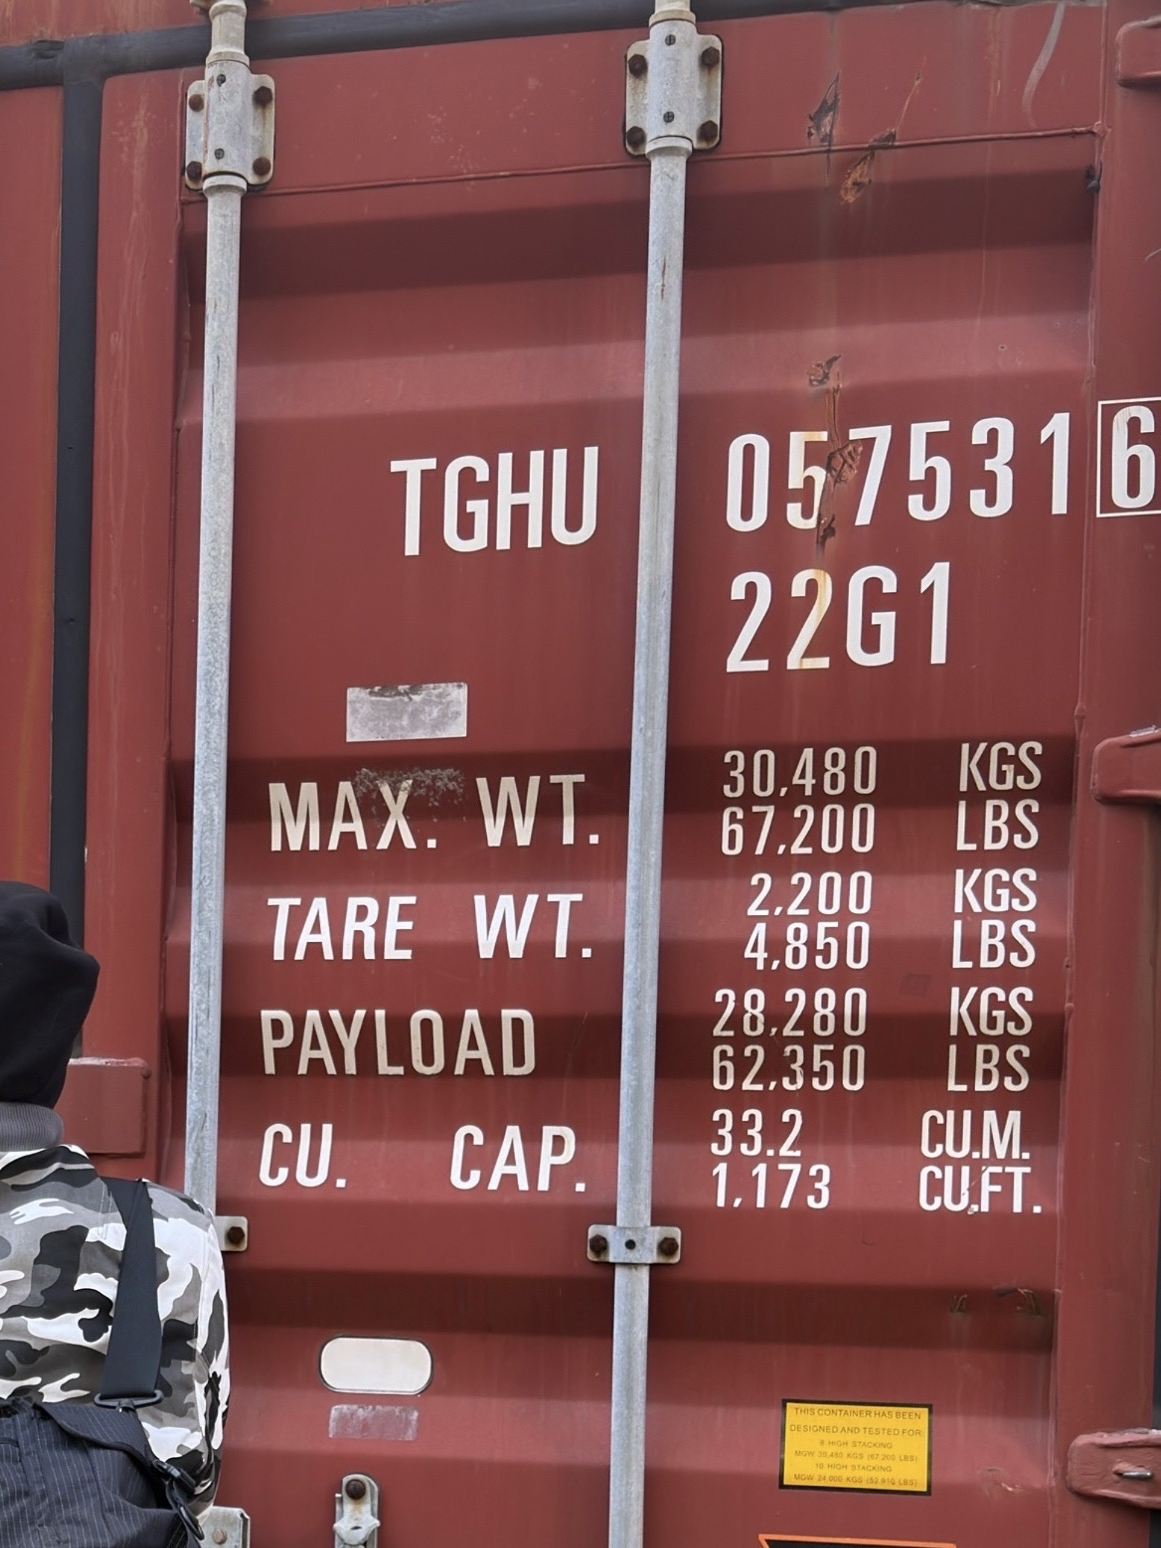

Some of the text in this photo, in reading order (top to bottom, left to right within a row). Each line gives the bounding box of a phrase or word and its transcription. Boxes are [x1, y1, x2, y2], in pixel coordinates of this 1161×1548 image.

[390, 405, 1156, 556] TGHU 057531 6
[726, 561, 950, 673] 22G1
[269, 741, 1042, 851] MAX. WT. 30,480 KGS
[722, 799, 1039, 856] 67,200 LBS
[265, 868, 1039, 962] TARE WT. 2,200 KGS
[743, 920, 1037, 971] 4,850 LBS
[260, 986, 1033, 1076] PAYLOAD 28,280 KGS
[712, 1044, 1031, 1092] 62,350 LBS
[258, 1108, 1031, 1193] CU. CAP. 33.2 CU.M.
[712, 1162, 1043, 1215] 1,173 CU.FT.
[789, 1424, 838, 1434] DESIGNED
[840, 1425, 860, 1435] AND
[863, 1427, 900, 1436] TESTED
[794, 1407, 922, 1420] THIS CONTAINER HAS BEEN
[794, 1450, 814, 1458] MGW
[846, 1452, 864, 1460] KGS
[827, 1463, 848, 1471] HIGH
[851, 1464, 892, 1472] STACKING
[828, 1440, 849, 1448] HIGH
[852, 1441, 893, 1449] STACKING
[794, 1473, 814, 1482] MGW
[846, 1476, 863, 1484] KGS
